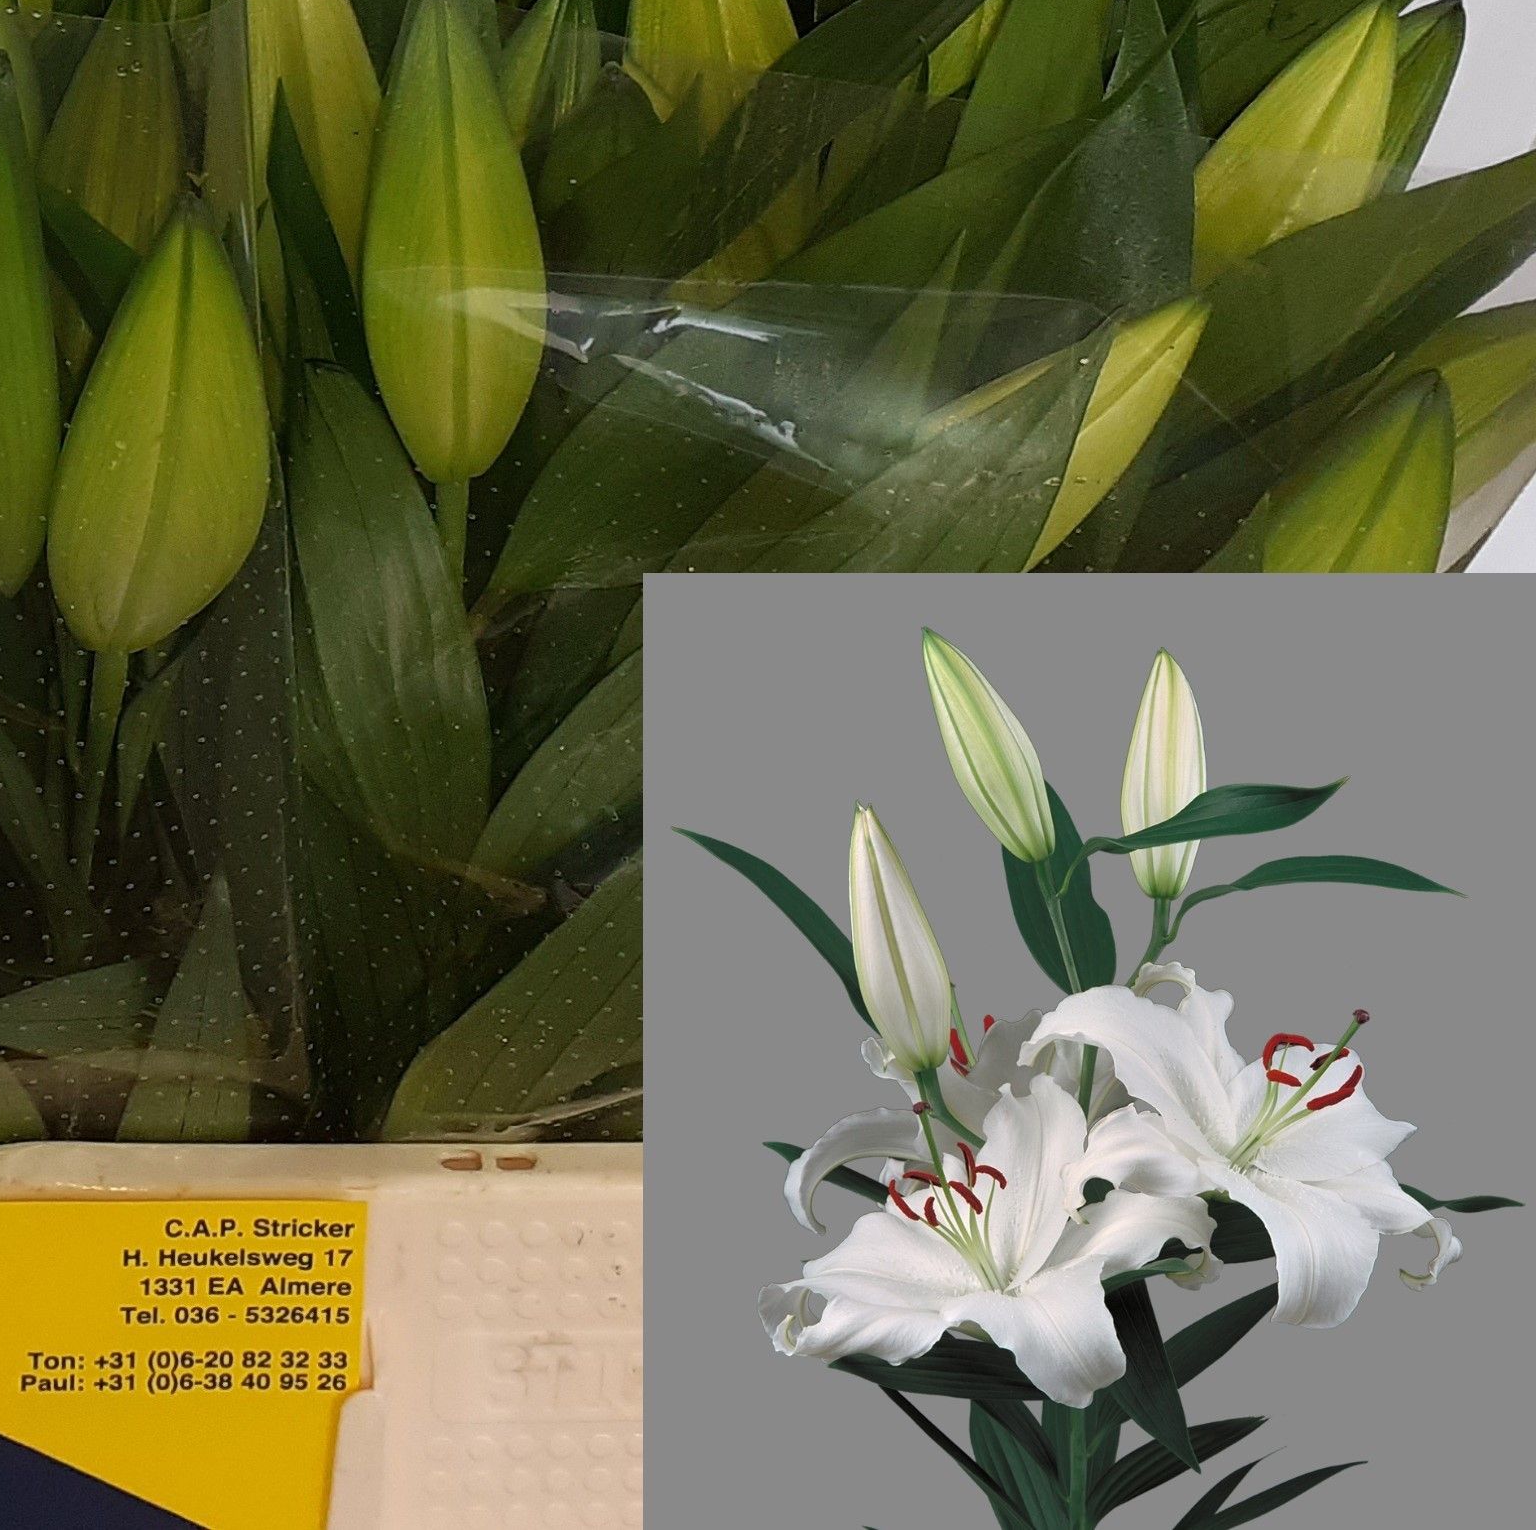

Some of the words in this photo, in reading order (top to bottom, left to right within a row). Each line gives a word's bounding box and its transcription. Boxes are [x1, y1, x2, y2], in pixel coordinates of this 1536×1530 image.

[165, 1218, 243, 1238] C.A.P.
[253, 1218, 355, 1238] Stricker
[123, 1249, 148, 1267] H.
[158, 1248, 314, 1271] Heukelsweg
[324, 1249, 354, 1267] 17
[140, 1277, 195, 1296] 1331
[208, 1276, 244, 1296] EA
[260, 1277, 352, 1296] Almere
[120, 1306, 166, 1324] Tel.
[174, 1306, 220, 1324] 036
[245, 1306, 350, 1324] 5326415
[27, 1352, 85, 1370] Ton:
[94, 1352, 135, 1370] +31
[148, 1350, 234, 1375] (0)6-20
[241, 1350, 272, 1369] 82
[280, 1350, 310, 1369] 32
[318, 1351, 348, 1369] 33
[20, 1374, 84, 1392] Paul:
[93, 1374, 135, 1391] +31
[147, 1372, 233, 1395] (0)6-38
[241, 1373, 271, 1390] 40
[279, 1373, 308, 1391] 95
[317, 1373, 347, 1391] 26
